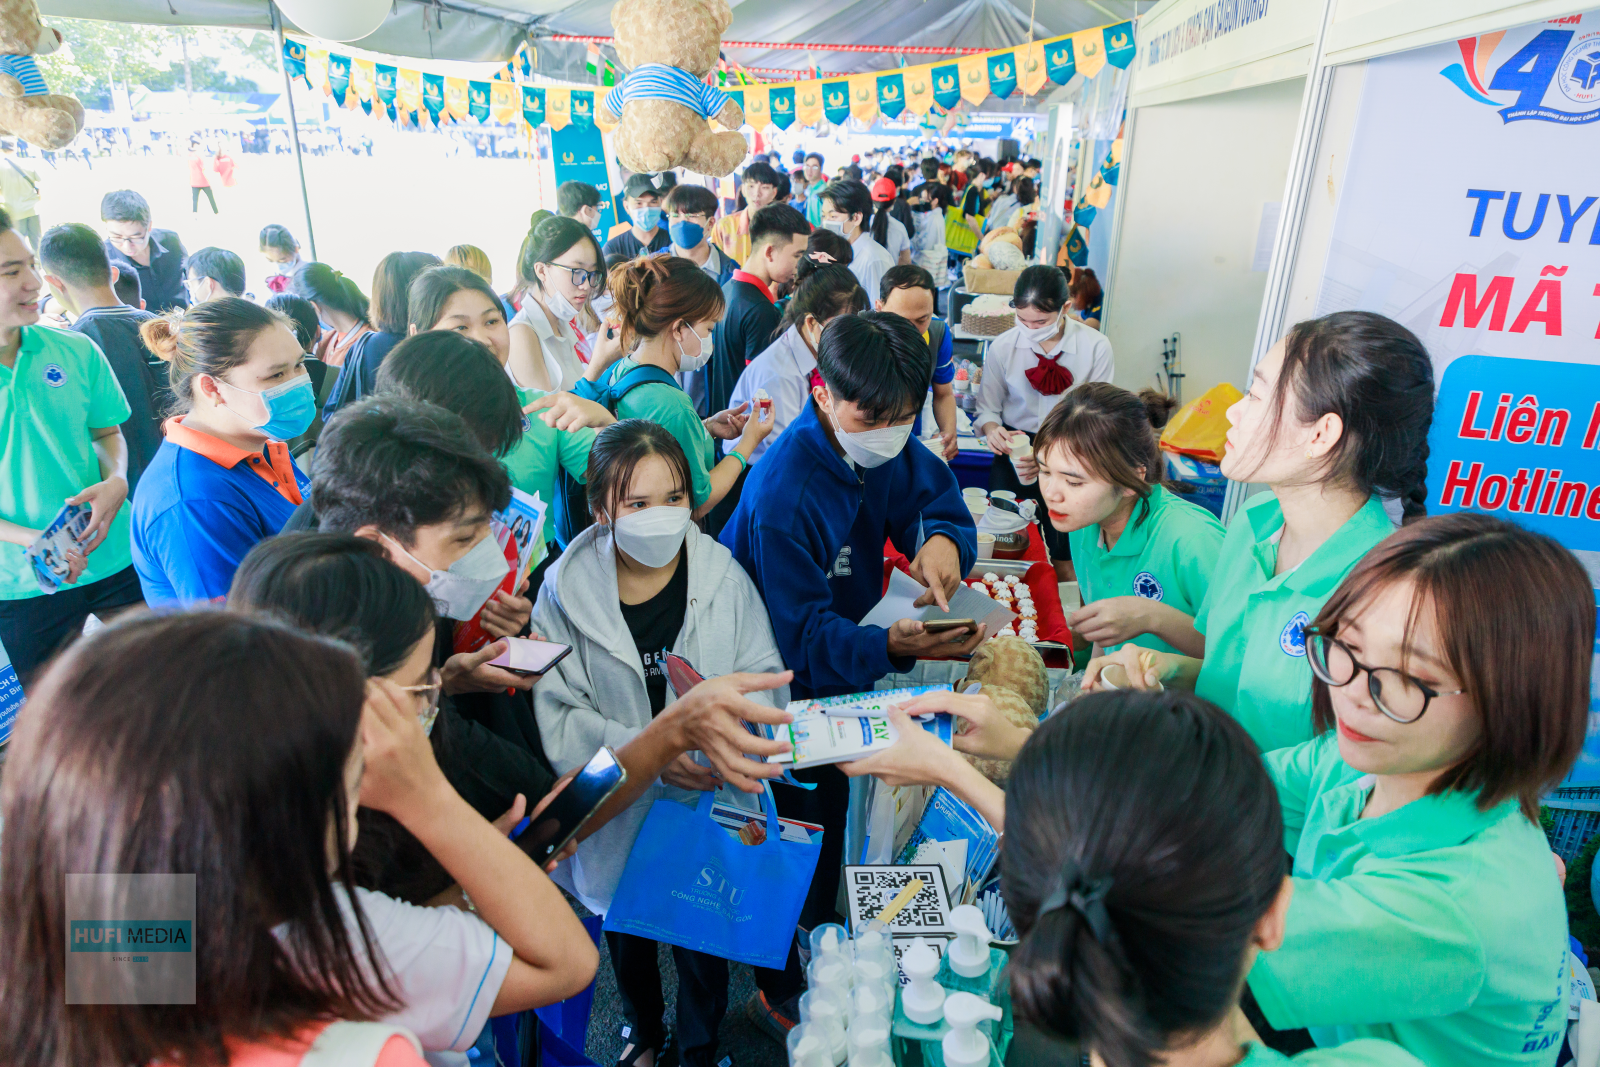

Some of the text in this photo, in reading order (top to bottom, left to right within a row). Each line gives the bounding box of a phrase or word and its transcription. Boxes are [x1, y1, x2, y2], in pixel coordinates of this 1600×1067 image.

[1507, 110, 1526, 119] THÀNH
[1527, 109, 1538, 117] LẬP
[1439, 264, 1569, 337] MÃ
[1458, 390, 1571, 447] Liên
[671, 889, 696, 902] CÔNG
[696, 866, 748, 906] STU
